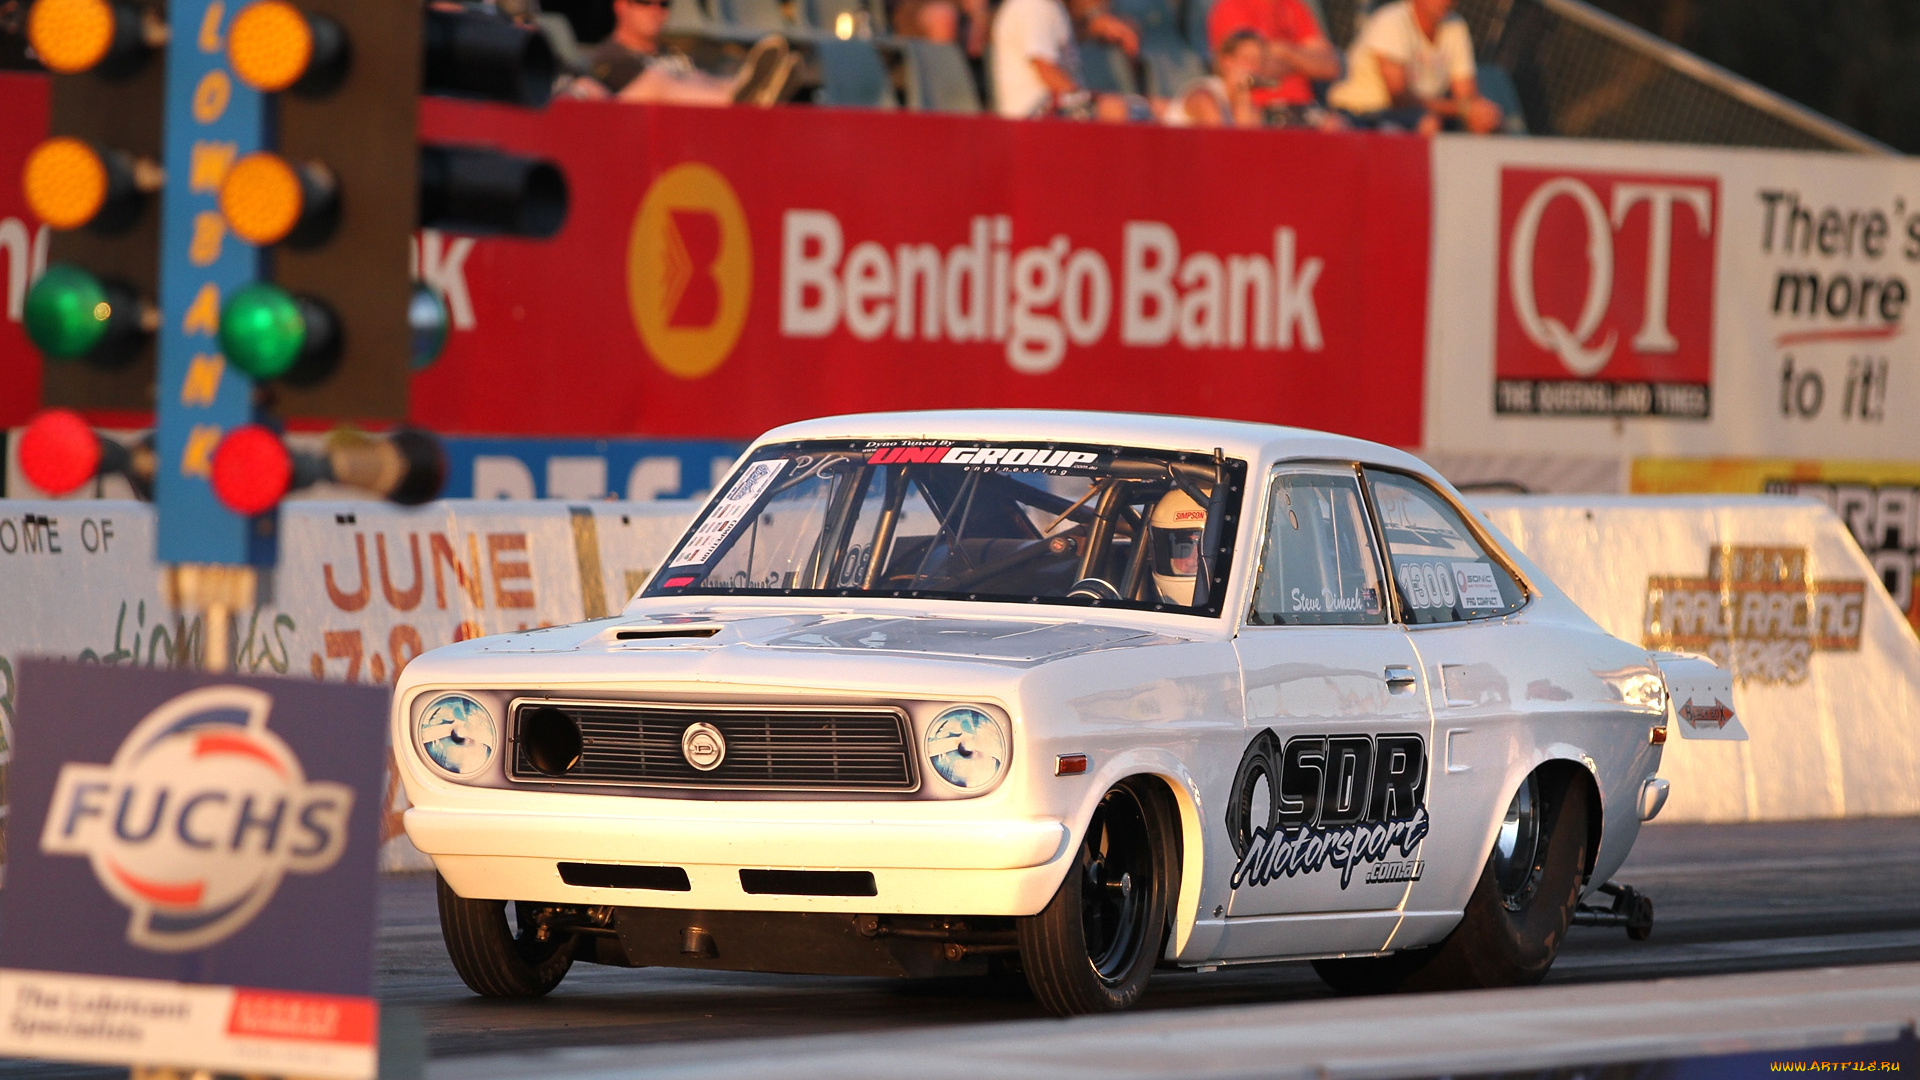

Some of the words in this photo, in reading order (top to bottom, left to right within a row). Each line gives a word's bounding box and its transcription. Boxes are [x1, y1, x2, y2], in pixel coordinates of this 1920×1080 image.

[1757, 188, 1920, 260] There's
[780, 209, 1112, 374] Bendigo
[1120, 220, 1324, 351] Bank
[1508, 174, 1713, 377] QT
[1772, 267, 1907, 322] more
[1779, 355, 1824, 418] to
[1843, 355, 1888, 422] it!
[865, 440, 898, 449] Dyno
[867, 447, 1099, 468] UNIGROUP
[963, 464, 1068, 476] engineering
[81, 517, 114, 552] OF
[1175, 511, 1205, 520] SIMPSON
[323, 531, 536, 613] JUNE
[1291, 587, 1321, 611] Steve
[1398, 562, 1456, 609] 1300
[1279, 733, 1427, 830] SDR
[59, 781, 338, 859] FUCHS
[1231, 803, 1428, 889] Motorsport
[1366, 860, 1425, 884] .com.au
